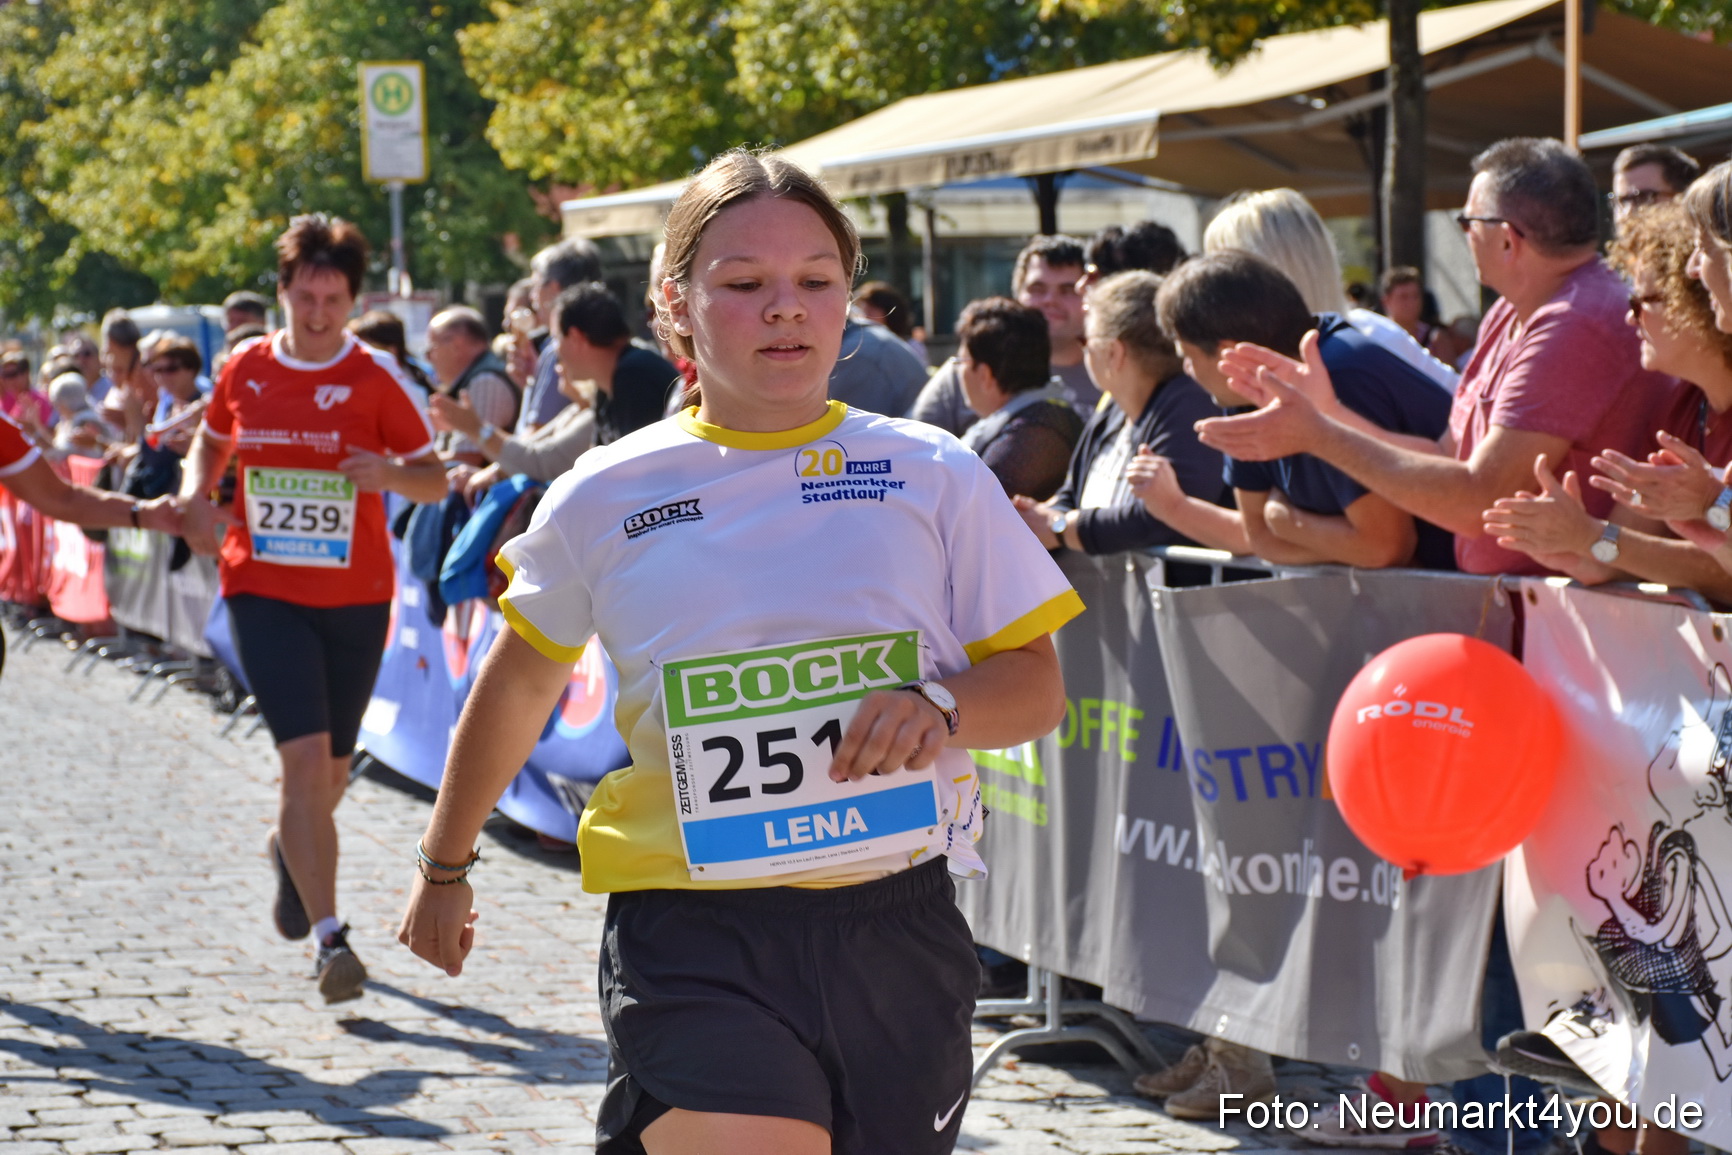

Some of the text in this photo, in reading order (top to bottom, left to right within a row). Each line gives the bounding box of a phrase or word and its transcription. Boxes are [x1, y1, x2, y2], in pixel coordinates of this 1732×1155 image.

[801, 449, 887, 476] 20 JAHRE
[255, 471, 345, 497] BOCK
[801, 478, 905, 491] Neumarkter
[802, 489, 887, 503] Stadtlauf
[258, 502, 340, 532] 2259
[624, 498, 702, 533] BOCK
[266, 540, 329, 555] ANGELA
[680, 639, 902, 717] BOCK
[1357, 683, 1475, 728] RÖDL
[1412, 718, 1471, 739] energie
[702, 718, 881, 803] 251
[764, 807, 869, 848] LENA
